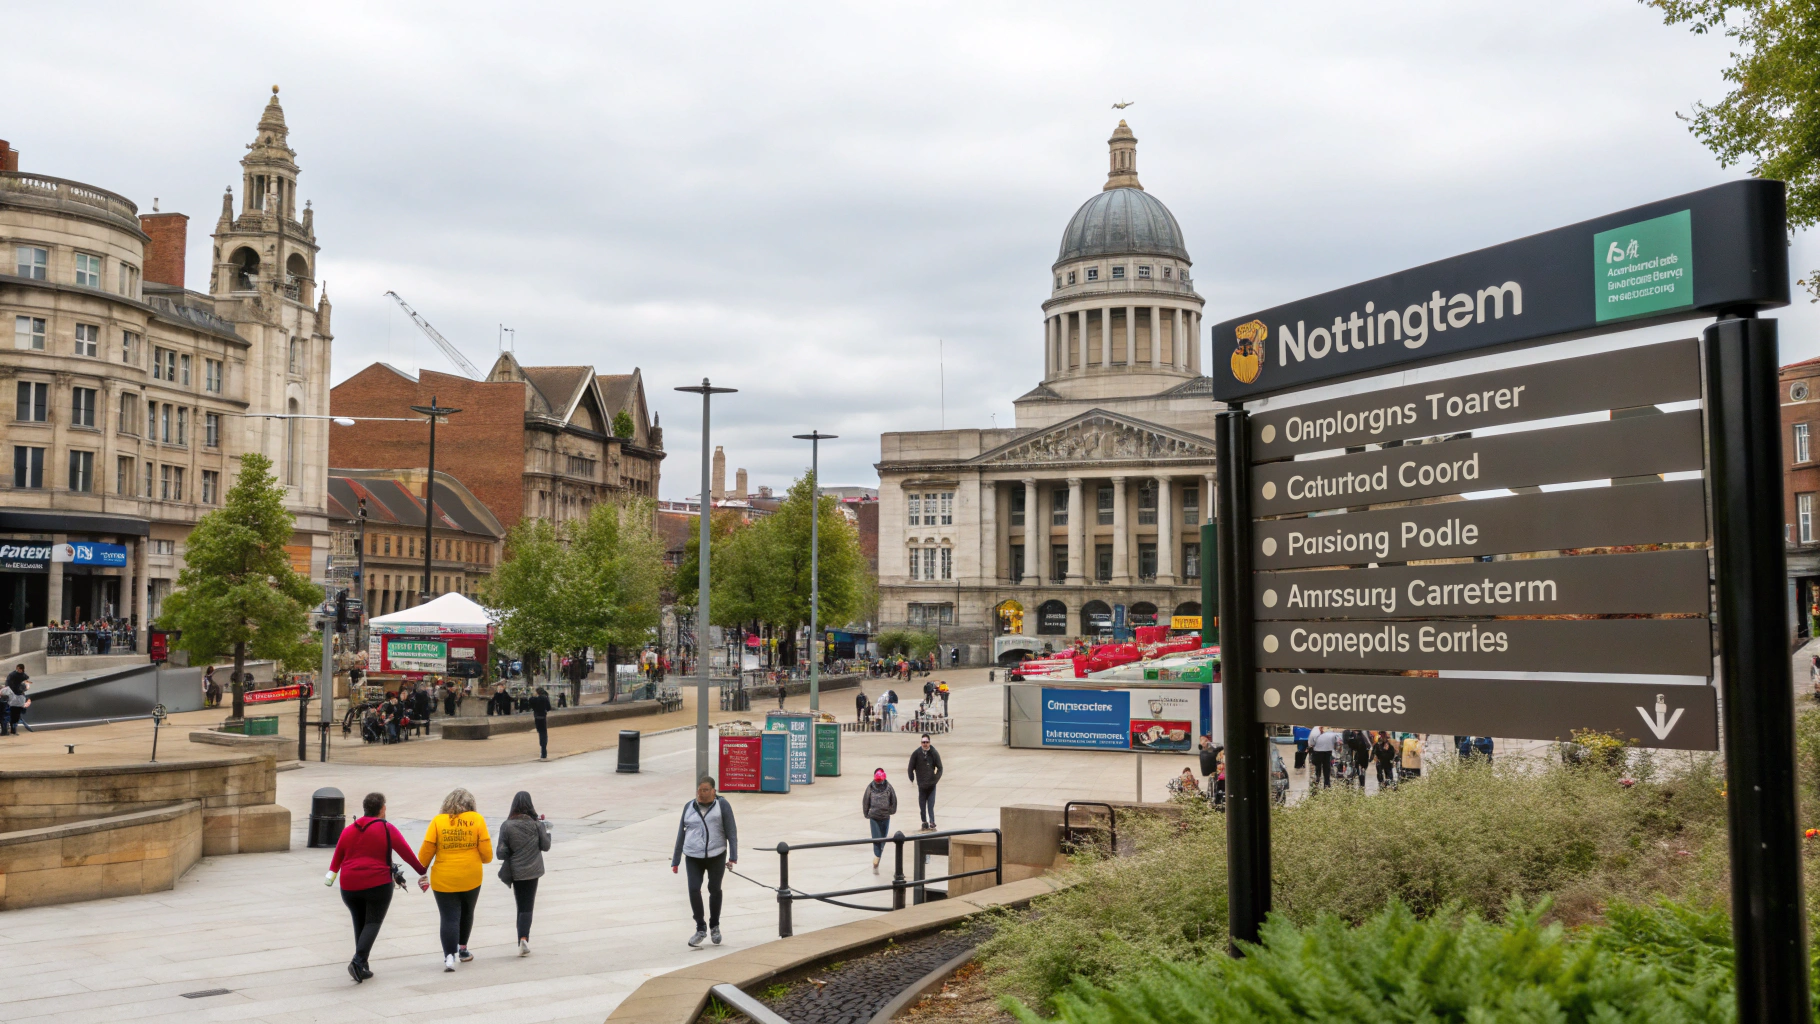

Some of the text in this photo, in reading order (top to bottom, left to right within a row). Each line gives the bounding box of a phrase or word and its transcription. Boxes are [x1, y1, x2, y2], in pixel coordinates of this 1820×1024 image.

[1426, 386, 1524, 419] Toarer
[1399, 453, 1478, 487] Coord
[1402, 519, 1478, 547] Podle
[1408, 579, 1556, 606] Carreterm
